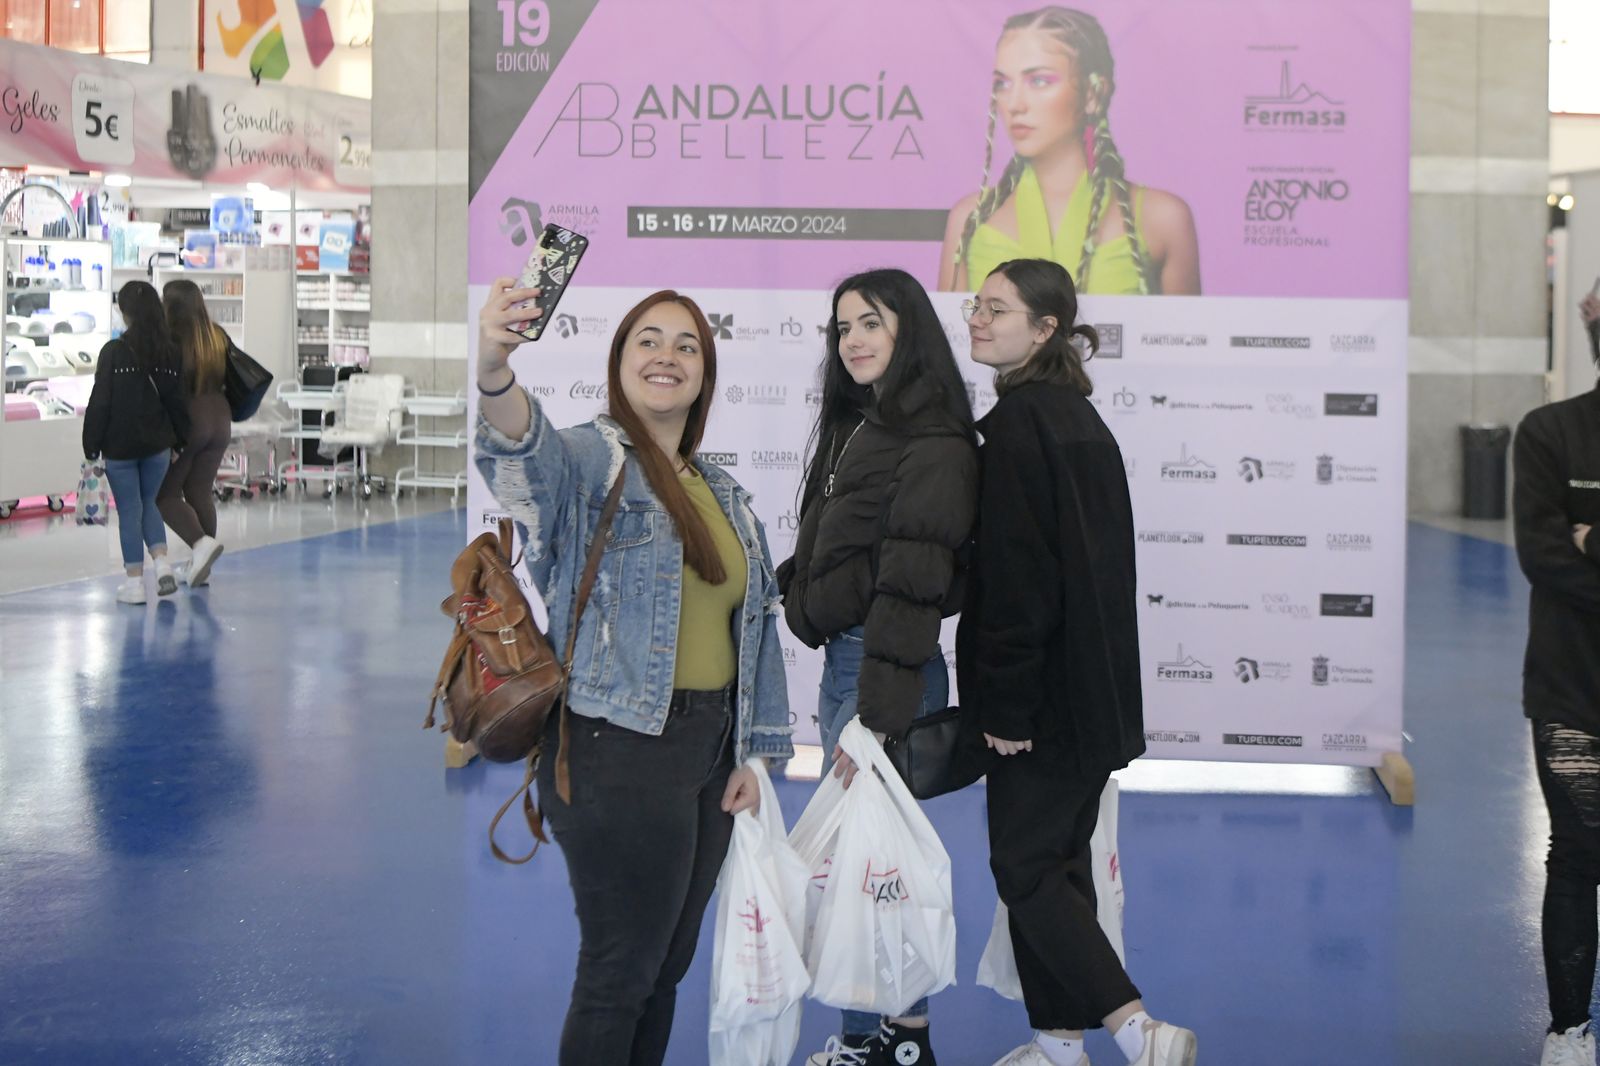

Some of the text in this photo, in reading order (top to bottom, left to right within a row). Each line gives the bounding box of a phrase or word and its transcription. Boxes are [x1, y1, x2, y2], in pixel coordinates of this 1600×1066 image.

[497, 0, 550, 47] 19
[496, 49, 550, 72] EDICIÓN
[633, 71, 923, 121] ANDALUCÍA
[2, 89, 60, 137] Geles
[85, 100, 119, 141] 5€
[223, 103, 295, 136] Esmaltes
[1244, 105, 1346, 126] Fermasa
[631, 123, 924, 160] BELLEZA
[224, 136, 325, 174] Permanentes
[1246, 180, 1349, 201] ANTONIO
[548, 204, 601, 216] ARMILLA
[1244, 200, 1298, 221] ELOY
[636, 212, 847, 236] 15 16 17 MARZO 2024
[1330, 334, 1376, 346] CAZCARRA
[751, 451, 799, 463] CAZCARRA
[1160, 467, 1216, 480] Fermasa
[1241, 536, 1306, 547] TUPELU.COM
[1326, 533, 1372, 545] CAZCARRA
[1157, 667, 1213, 681] Fermasa
[1237, 736, 1303, 747] TUPELU.COM
[1321, 733, 1367, 746] CAZCARRA
